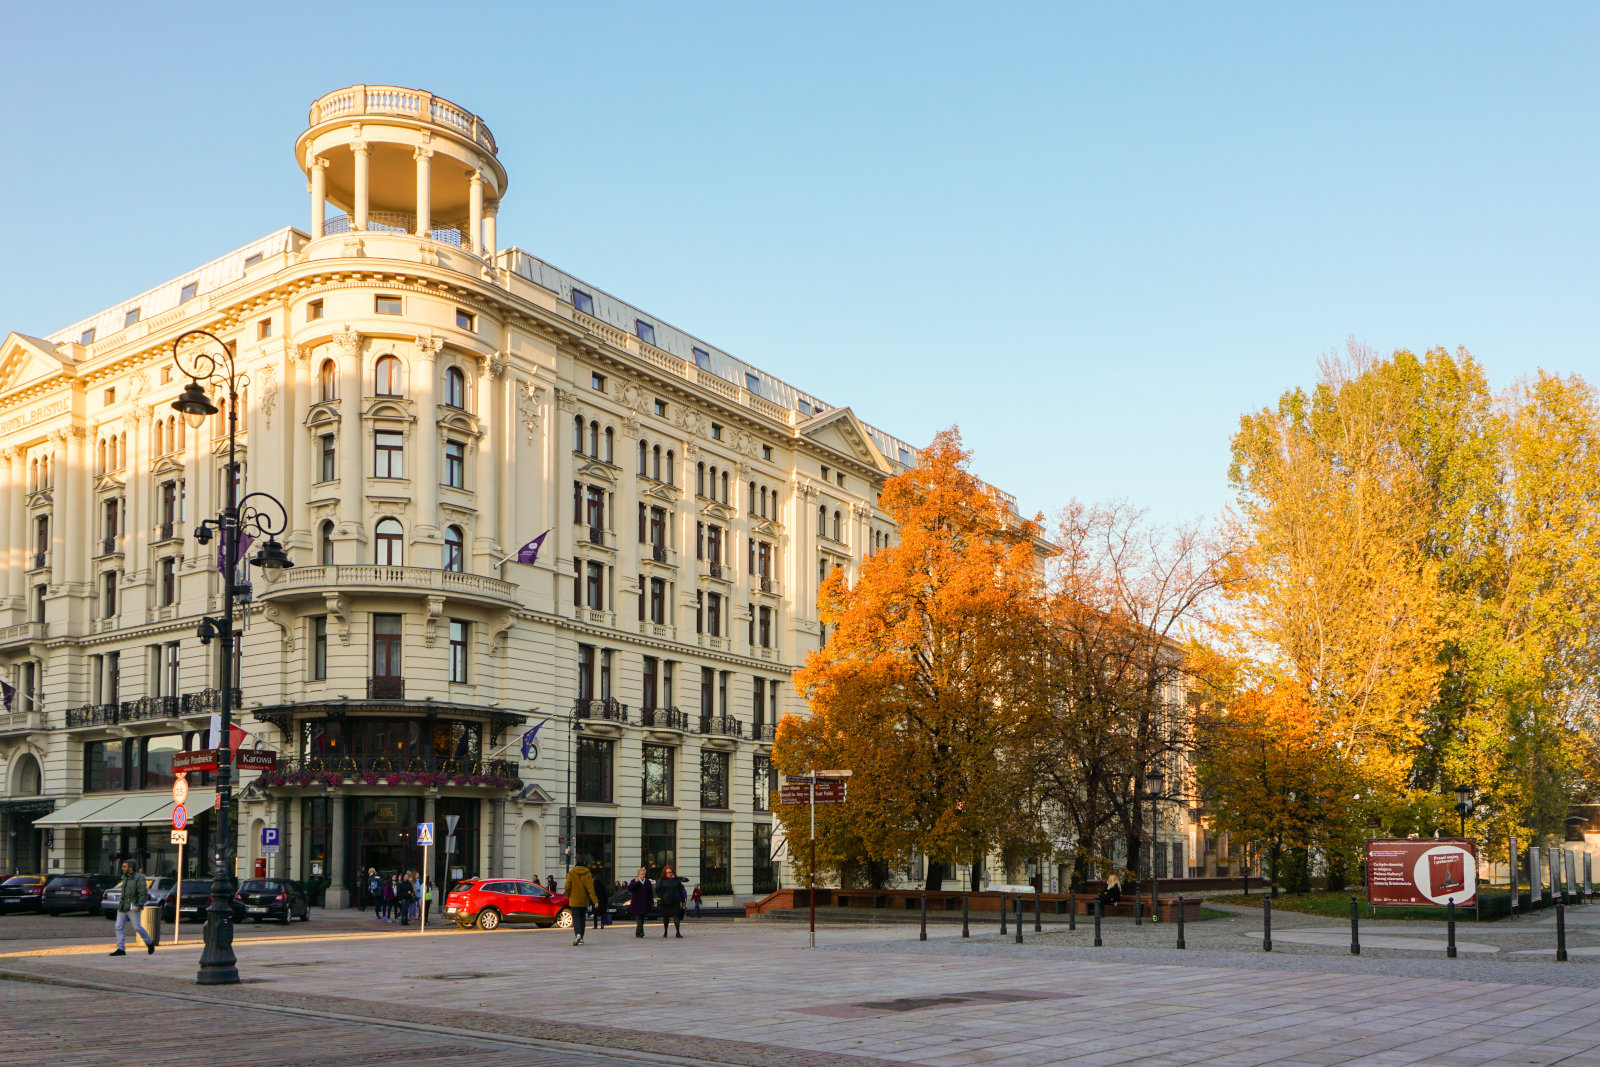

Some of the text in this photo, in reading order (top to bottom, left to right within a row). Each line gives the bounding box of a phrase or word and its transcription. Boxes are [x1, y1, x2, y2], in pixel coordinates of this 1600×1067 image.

[1, 397, 70, 434] HOTEL BRISTOL
[242, 754, 272, 764] Karowa
[265, 829, 277, 844] P
